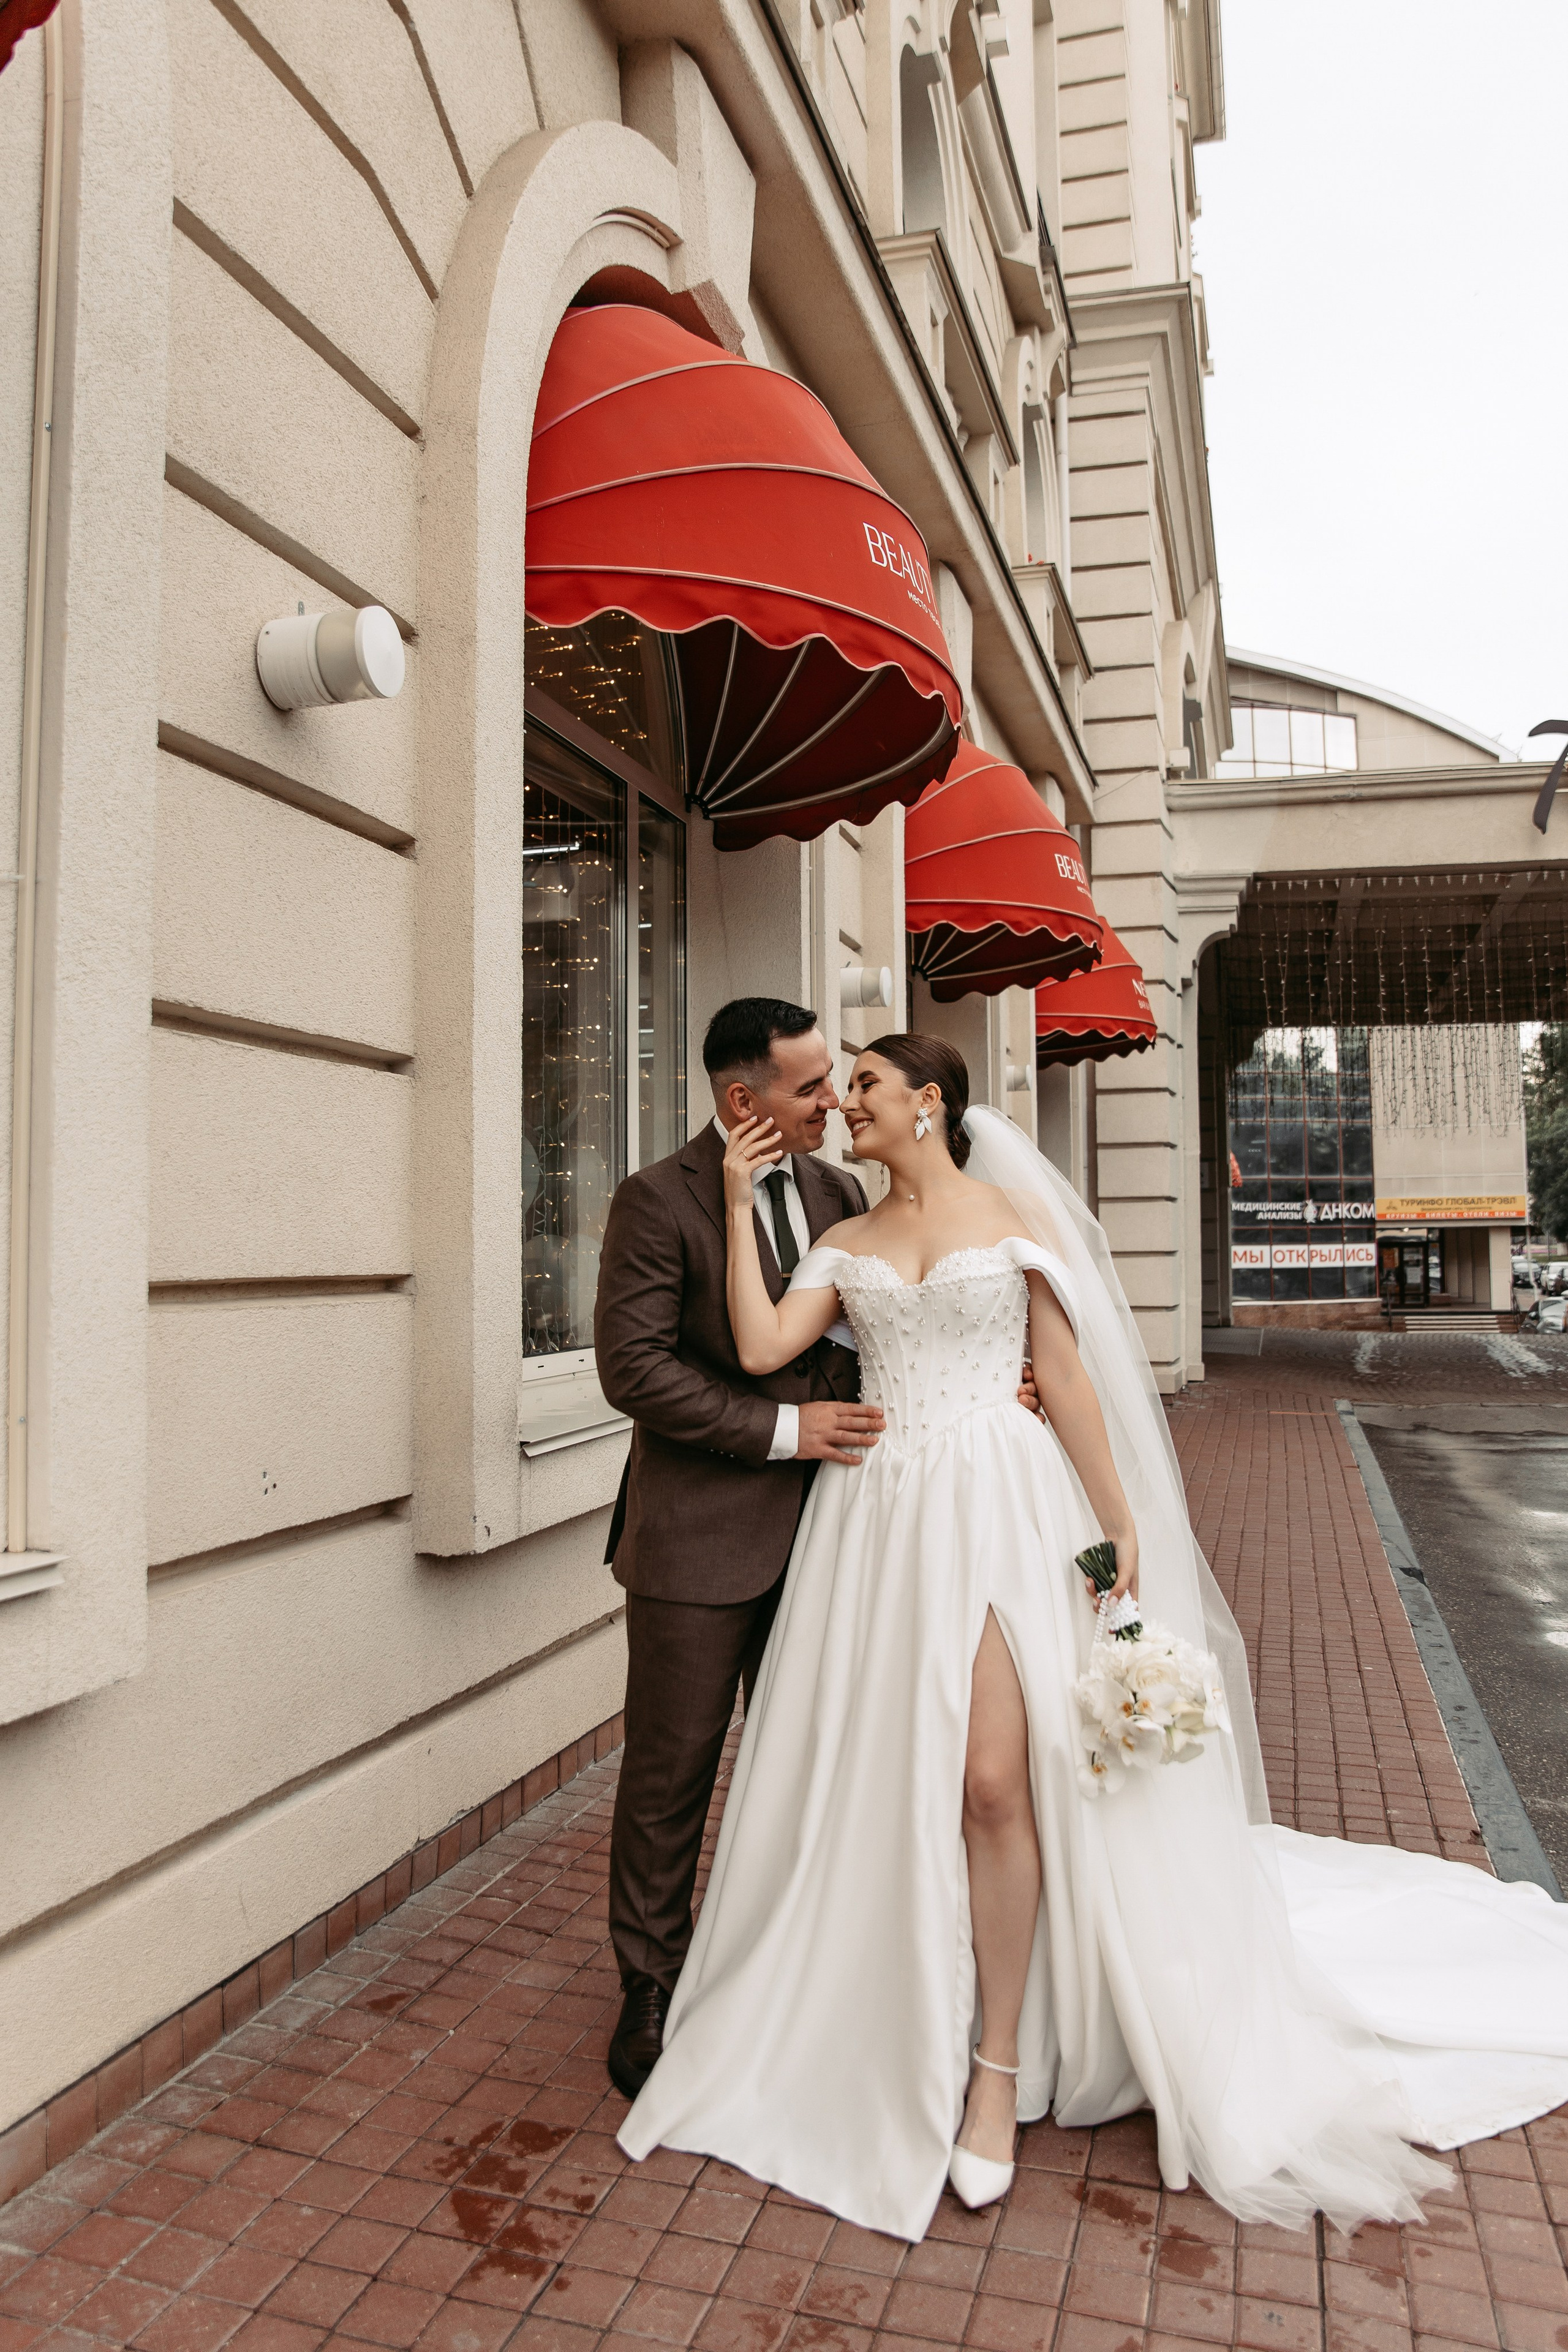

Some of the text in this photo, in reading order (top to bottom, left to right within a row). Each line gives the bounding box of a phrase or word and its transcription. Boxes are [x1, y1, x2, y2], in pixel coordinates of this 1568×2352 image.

[1231, 1202, 1302, 1212] МЕДИЦИНСКИЕ
[1400, 1197, 1517, 1207] ТУРИНФО ГЛОБАЛ-ТРЭВЛ
[1256, 1211, 1302, 1220] АНАЛИЗЫ
[1320, 1202, 1375, 1221] ДНКОМ
[1232, 1248, 1374, 1264] МЫ ОТКРЫЛИСЬ
